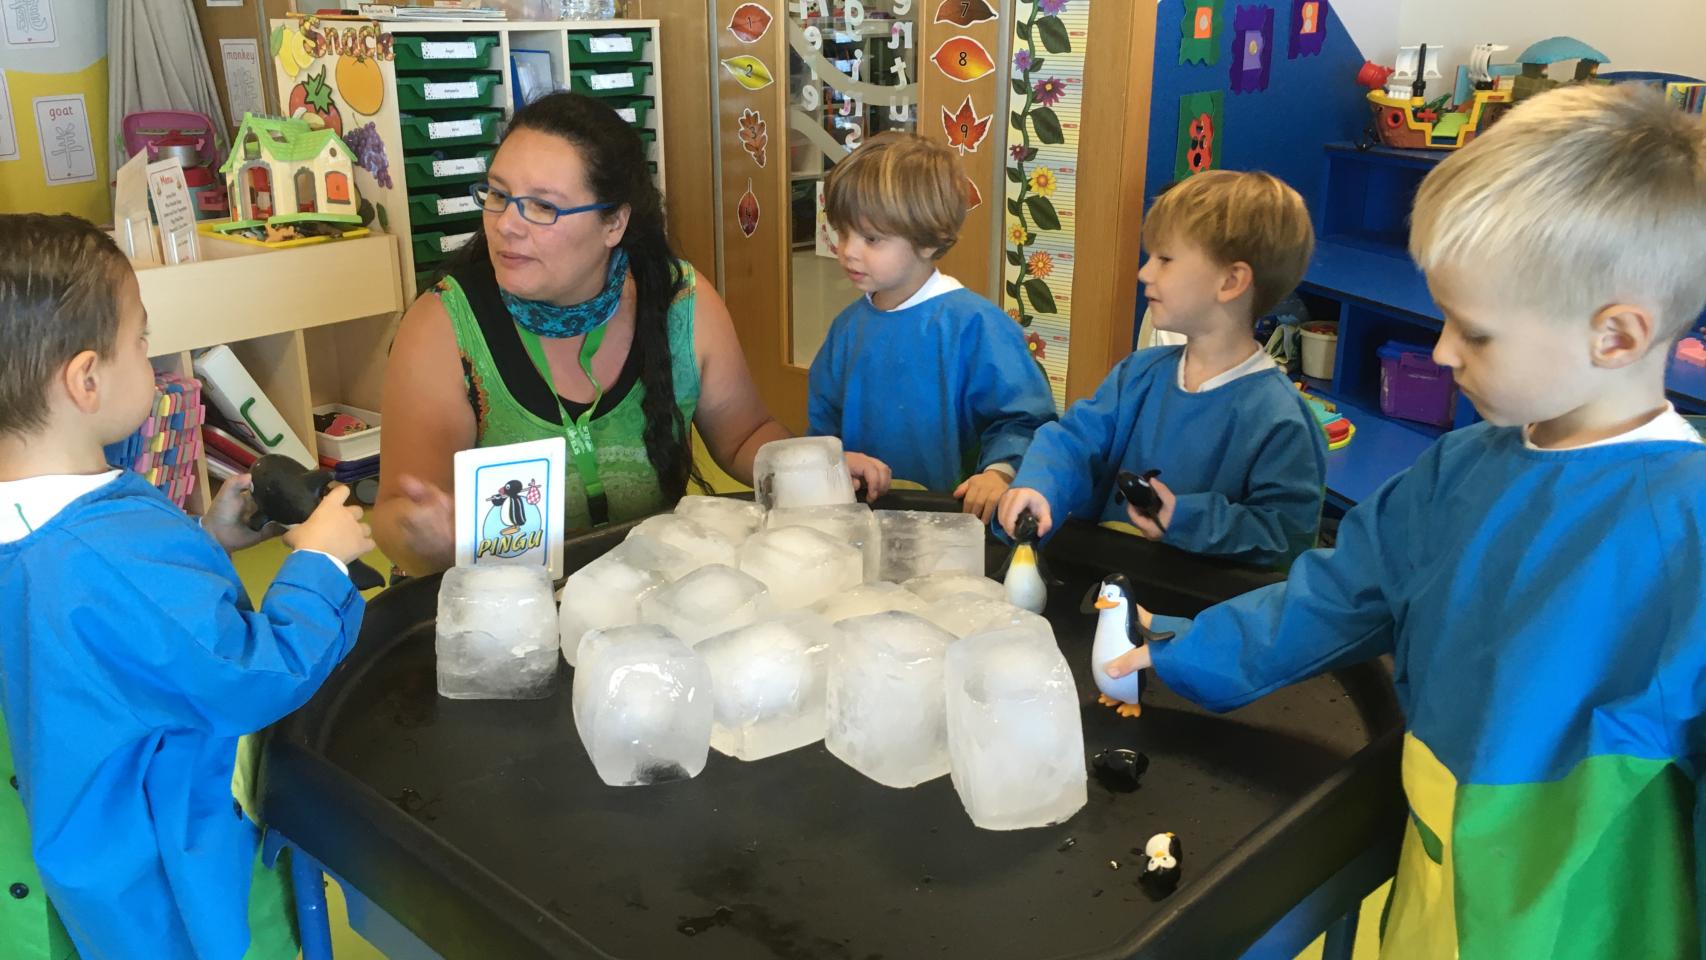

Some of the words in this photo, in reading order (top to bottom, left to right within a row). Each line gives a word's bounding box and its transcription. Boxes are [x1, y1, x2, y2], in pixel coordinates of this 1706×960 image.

[961, 2, 970, 17] 7
[747, 16, 752, 28] 1
[299, 15, 396, 61] Snack
[226, 49, 256, 65] monkey
[958, 52, 967, 66] 8
[745, 64, 753, 78] 2
[49, 106, 73, 121] goat
[750, 126, 757, 138] 3
[961, 124, 969, 139] 9
[745, 207, 751, 219] 4
[477, 530, 543, 558] PINGU
